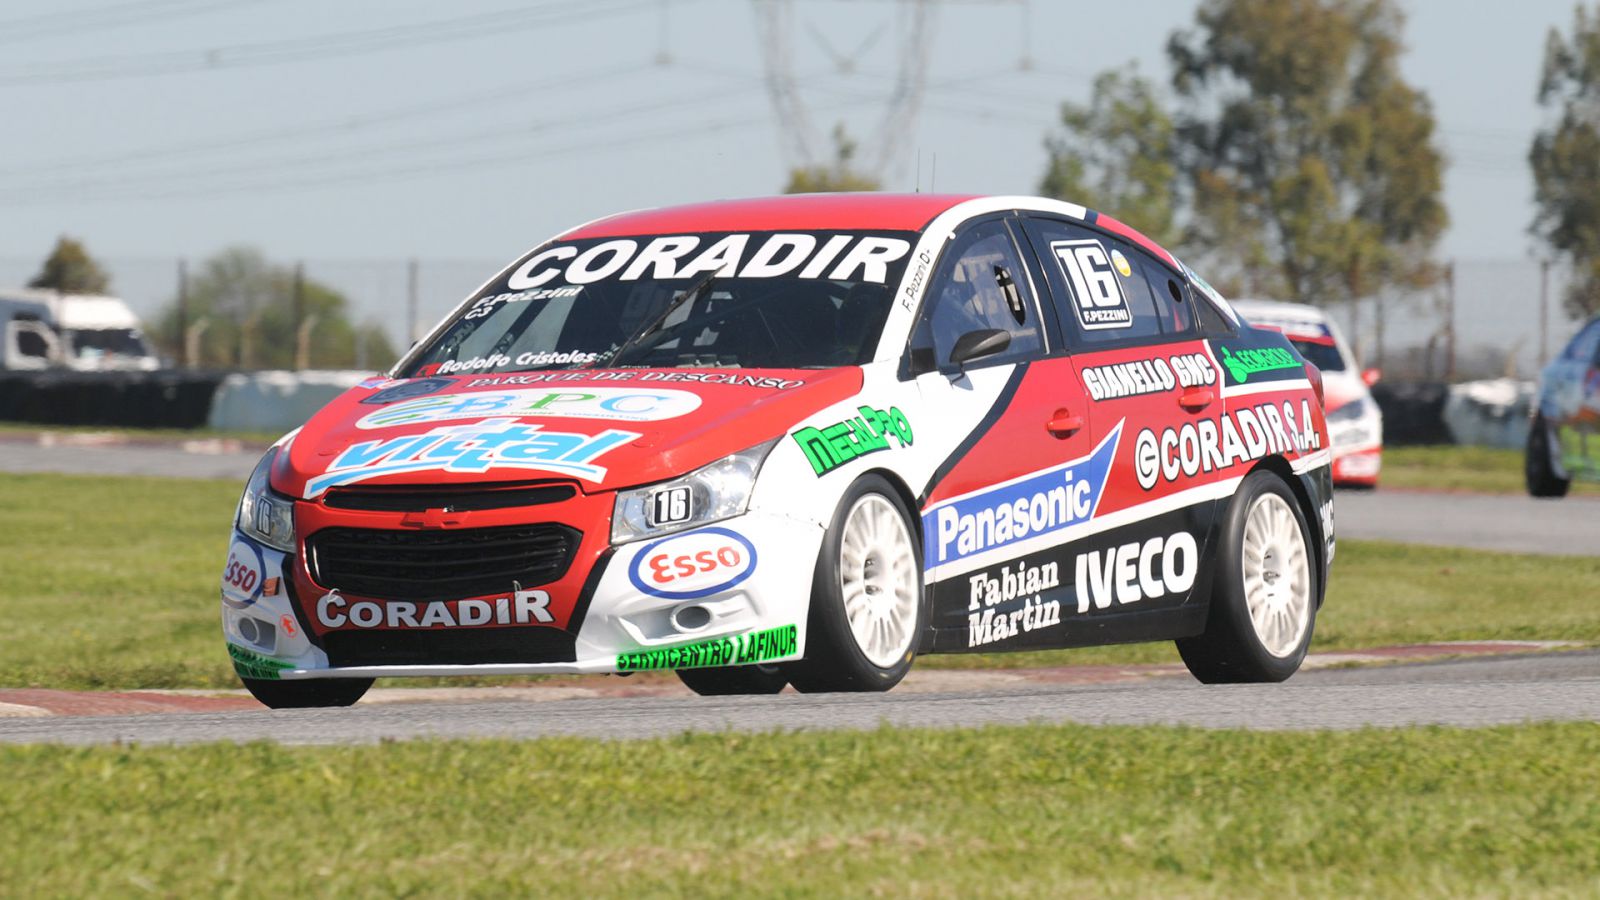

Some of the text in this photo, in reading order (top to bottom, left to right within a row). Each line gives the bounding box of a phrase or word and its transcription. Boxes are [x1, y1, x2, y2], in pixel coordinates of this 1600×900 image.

[508, 233, 912, 289] CORADIR
[905, 261, 927, 301] Pezzini
[1055, 247, 1121, 308] 16
[1083, 308, 1129, 322] F.PEZZINI
[437, 350, 597, 374] Rodolfo Cristales
[465, 371, 805, 390] PARQUE DE DESCANSO
[1081, 359, 1176, 402] GIANELLO
[1159, 408, 1295, 482] CORADIR
[257, 498, 272, 535] 16
[657, 490, 686, 522] 16
[937, 470, 1092, 562] Panasonic
[648, 546, 742, 584] Esso
[968, 561, 1059, 612] Fabian
[1075, 531, 1199, 614] IVECO
[316, 591, 554, 628] CORADIR
[967, 598, 1061, 648] Martin
[617, 624, 798, 670] SERVICENTRO LAFINUR
